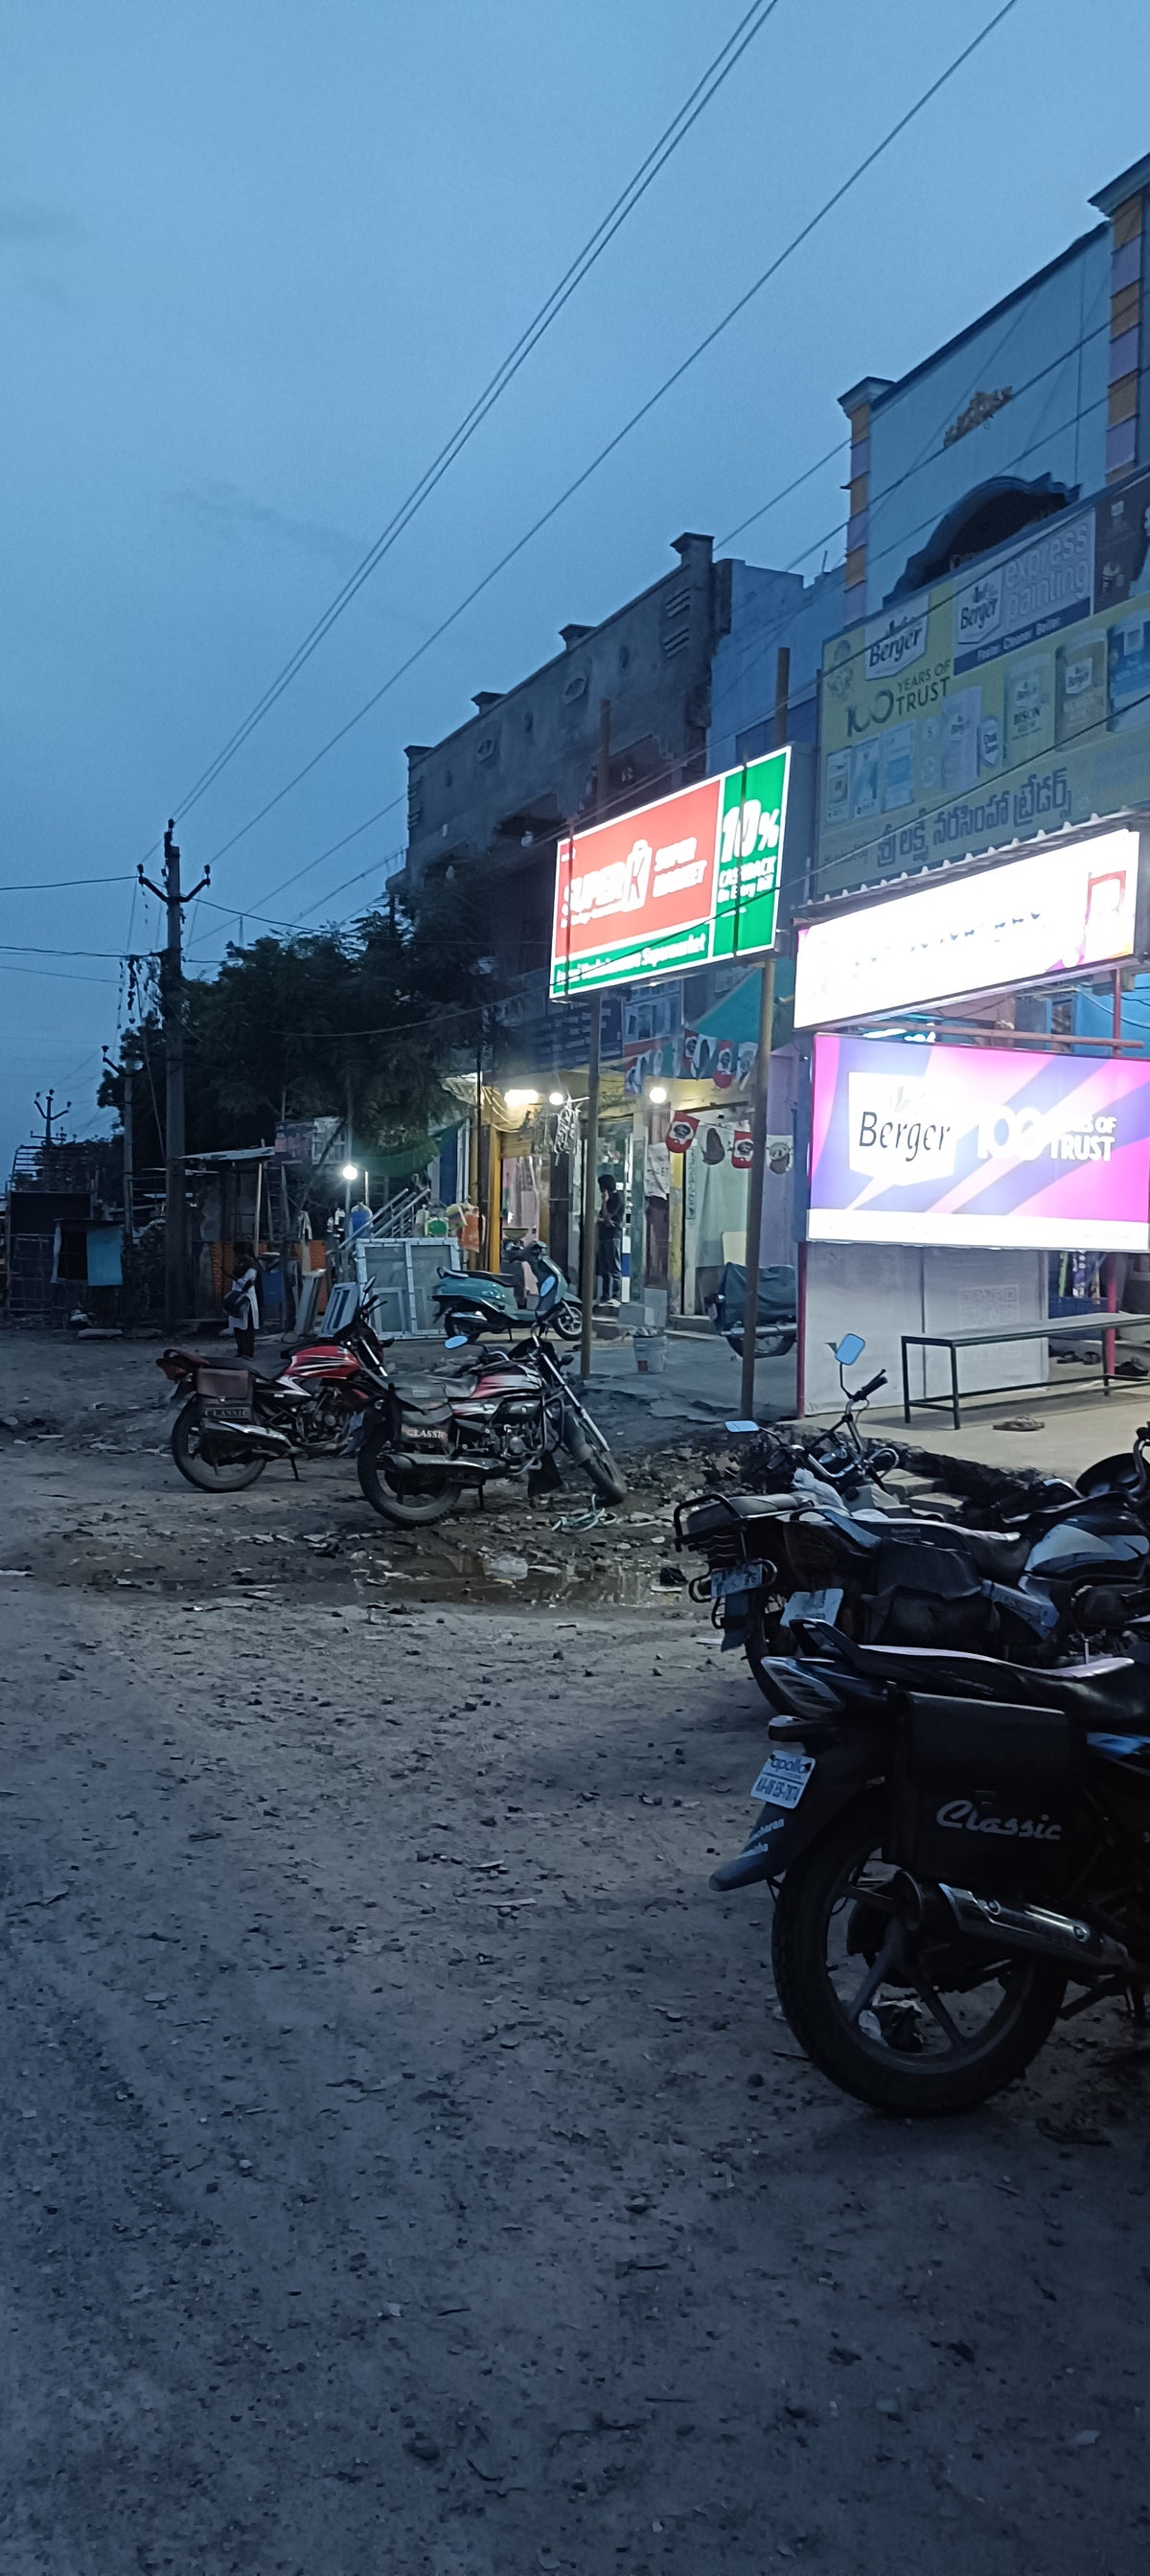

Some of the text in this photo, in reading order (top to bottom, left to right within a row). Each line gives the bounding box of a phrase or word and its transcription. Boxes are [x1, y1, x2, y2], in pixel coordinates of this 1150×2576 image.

[960, 598, 999, 629] Berger
[868, 628, 923, 667] Berger
[896, 676, 950, 716] TRUST
[898, 658, 952, 694] YEARS OF
[844, 688, 894, 738] 100
[721, 798, 780, 862] 10%
[859, 1111, 951, 1162] Berger
[978, 1106, 1045, 1162] 100
[1094, 1116, 1116, 1134] OF
[1050, 1134, 1115, 1162] TRUST
[936, 1799, 1062, 1841] Classic
